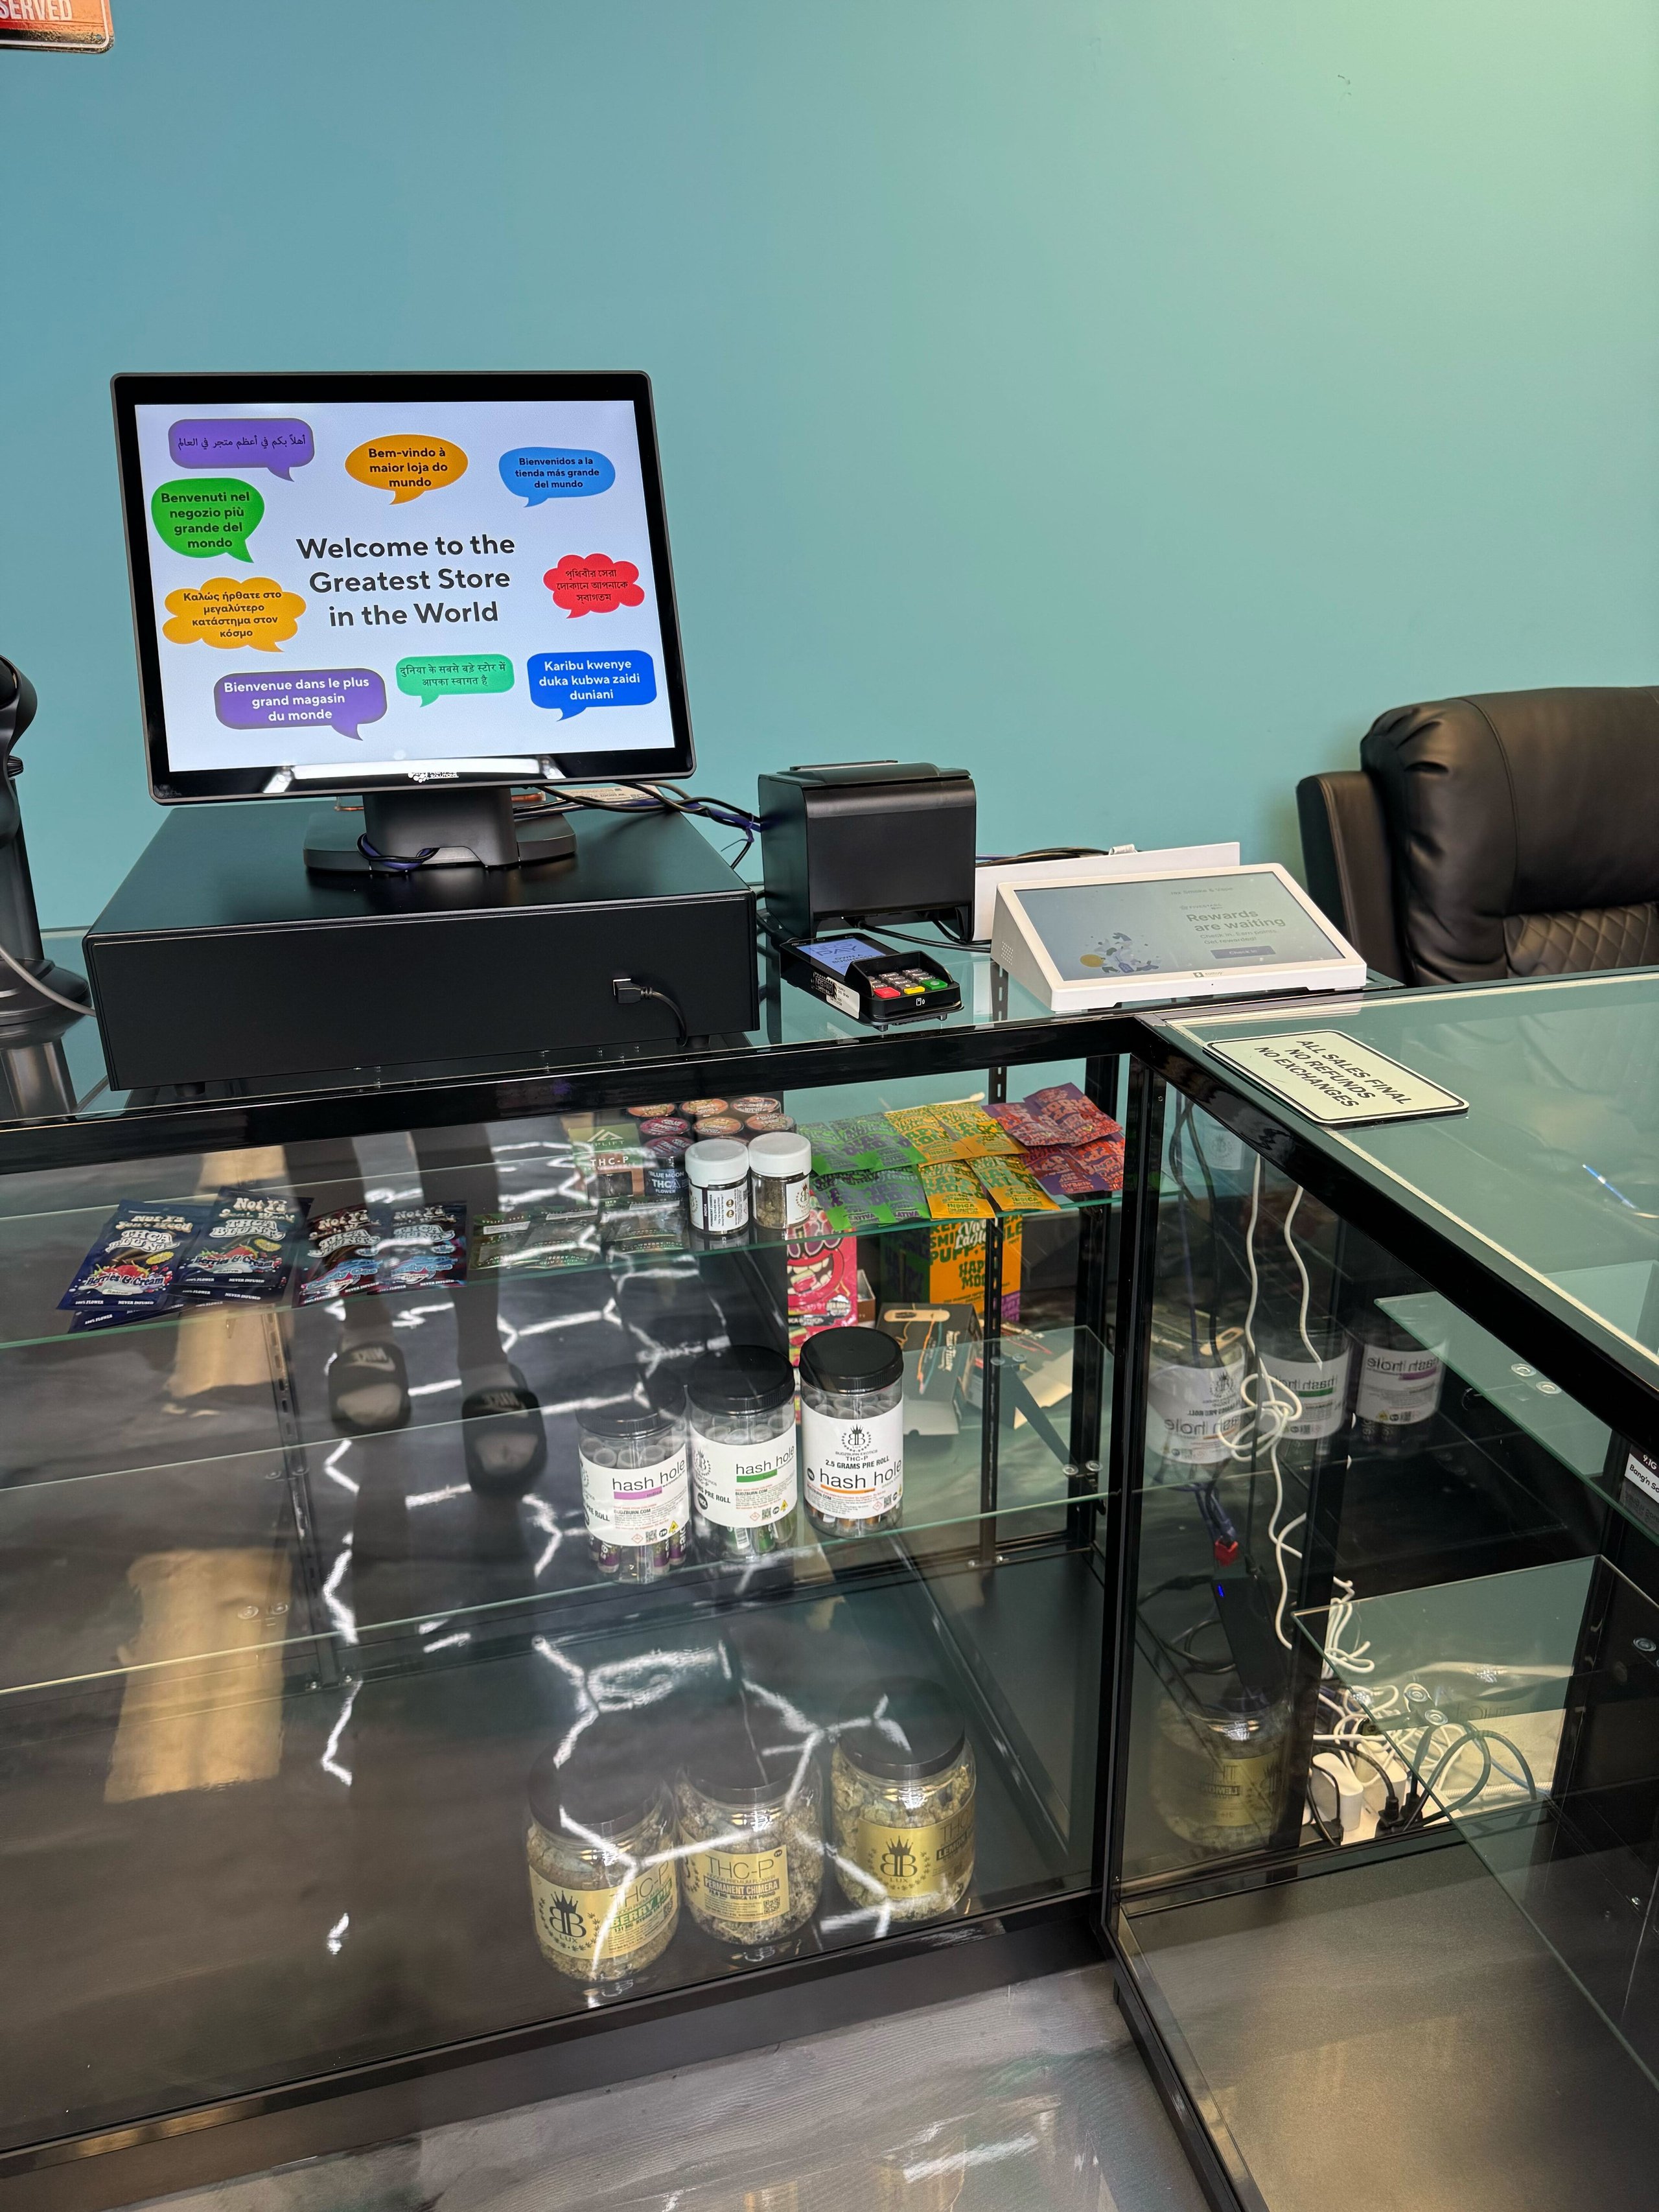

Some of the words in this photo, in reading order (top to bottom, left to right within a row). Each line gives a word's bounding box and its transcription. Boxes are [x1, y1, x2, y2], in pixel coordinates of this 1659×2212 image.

[178, 437, 198, 449] العالم
[200, 437, 209, 449] في
[213, 439, 233, 449] متجر
[235, 435, 258, 447] أعظم
[261, 436, 270, 448] في
[272, 436, 288, 447] بكم
[368, 447, 436, 459] Bem-vindo
[439, 447, 447, 458] à
[369, 463, 405, 473] maior
[406, 461, 430, 474] loja
[432, 462, 448, 472] do
[518, 457, 576, 466] Bienvenidos
[585, 457, 594, 465] la
[515, 469, 545, 478] tienda
[546, 467, 566, 477] más
[567, 468, 600, 478] grande
[388, 477, 432, 488] mundo
[533, 480, 550, 489] del
[551, 480, 583, 489] mundo
[161, 491, 227, 504] Benvenuti
[230, 491, 250, 502] nel
[169, 507, 221, 520] negozio
[224, 507, 244, 520] più
[174, 522, 220, 537] grande
[223, 522, 243, 533] del
[187, 537, 233, 549] mondo
[296, 539, 429, 559] Welcome
[435, 536, 463, 556] to
[470, 534, 516, 555] the
[309, 570, 430, 594] Greatest
[438, 568, 511, 590] Store
[183, 590, 220, 603] Καλώς
[221, 590, 261, 604] ήρθατε
[203, 603, 265, 616] μεγαλύτερο
[329, 605, 354, 627] in
[362, 604, 408, 625] the
[413, 601, 498, 623] World
[192, 614, 251, 627] κατάστημα
[253, 616, 279, 624] στον
[219, 629, 253, 640] κόσμο
[399, 664, 426, 677] दुनिया
[428, 664, 437, 675] के
[438, 662, 459, 674] सबसे
[476, 661, 496, 673] स्टोर
[497, 660, 507, 672] में
[544, 660, 585, 672] Karibu
[586, 659, 632, 673] kwenye
[224, 680, 292, 693] Bienvenue
[295, 678, 326, 690] dans
[328, 677, 340, 688] le
[343, 677, 370, 691] plus
[422, 676, 449, 687] आपका
[451, 675, 479, 686] स्वागत
[481, 674, 488, 686] है
[539, 675, 569, 687] duka
[570, 674, 610, 686] kubwa
[612, 673, 641, 684] zaidi
[251, 695, 290, 710] grand
[292, 693, 345, 708] magasin
[569, 689, 614, 701] duniani
[268, 710, 285, 722] du
[287, 708, 333, 721] monde
[1186, 910, 1259, 922] Rewards
[1194, 923, 1222, 932] are
[1224, 918, 1286, 929] waiting
[1254, 1047, 1280, 1058] NO
[1273, 1058, 1360, 1108] EXCHANGES
[1284, 1049, 1311, 1060] NO
[1305, 1060, 1376, 1100] REFUNDS
[1296, 1040, 1326, 1054] ALL
[1321, 1053, 1370, 1078] SALES
[1364, 1079, 1413, 1104] FINAL
[590, 1156, 630, 1167] THC-P
[233, 1197, 264, 1212] Not
[86, 1272, 121, 1288] Berries
[133, 1275, 166, 1288] Cream
[736, 1460, 772, 1475] hash
[776, 1445, 795, 1468] hole
[825, 1459, 835, 1467] 2.5
[876, 1455, 890, 1467] ROLL
[1643, 1454, 1657, 1470] 9.1G
[612, 1476, 655, 1491] hash
[659, 1459, 686, 1485] hole
[820, 1467, 866, 1489] hash
[874, 1460, 902, 1486] hole
[1629, 1463, 1651, 1483] Bang'n
[704, 1489, 715, 1499] PRE
[715, 1495, 731, 1504] ROLL
[594, 1511, 610, 1522] ROLL
[705, 1854, 774, 1880] THC-P
[705, 1877, 745, 1895] PERMANENT
[746, 1880, 778, 1895] CHIMERA
[612, 1902, 655, 1927] BERRY
[656, 1878, 673, 1905] PIE
[559, 1934, 579, 1944] LUX
